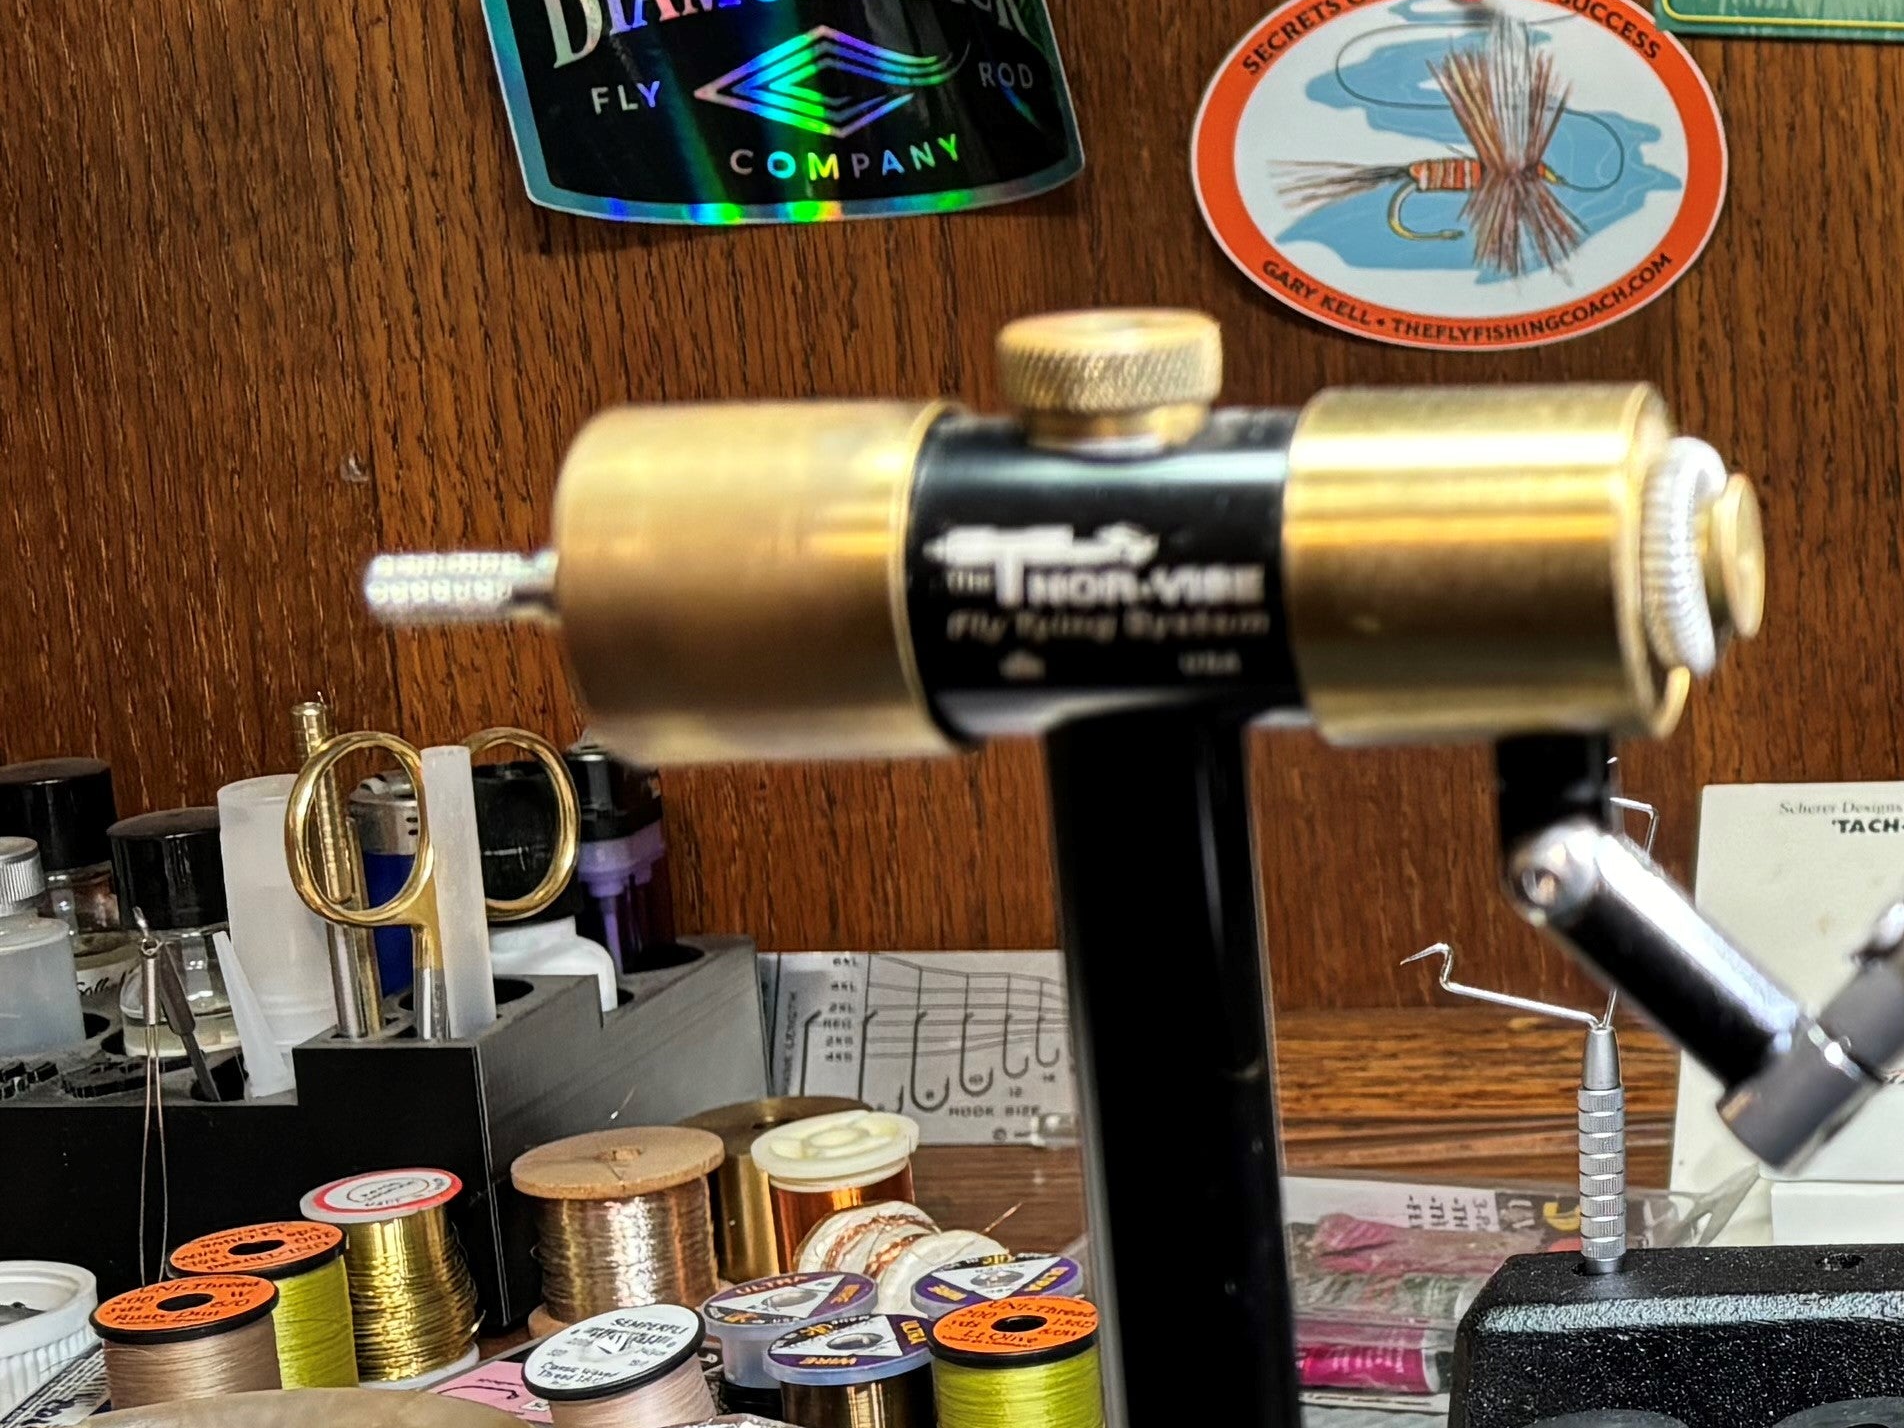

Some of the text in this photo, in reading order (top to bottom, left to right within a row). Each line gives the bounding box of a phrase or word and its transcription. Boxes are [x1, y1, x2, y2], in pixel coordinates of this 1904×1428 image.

[979, 62, 1033, 88] ROD
[591, 81, 661, 115] FLY
[729, 134, 961, 180] COMPANY
[1262, 253, 1673, 343] GARY KELL THEFLYFISHINGCOACH.COM
[1842, 801, 1903, 815] Designs
[736, 1275, 808, 1295] ULTRA
[960, 1310, 997, 1319] 200
[988, 1301, 1097, 1317] UNI-Thread
[989, 1333, 1038, 1343] Olive
